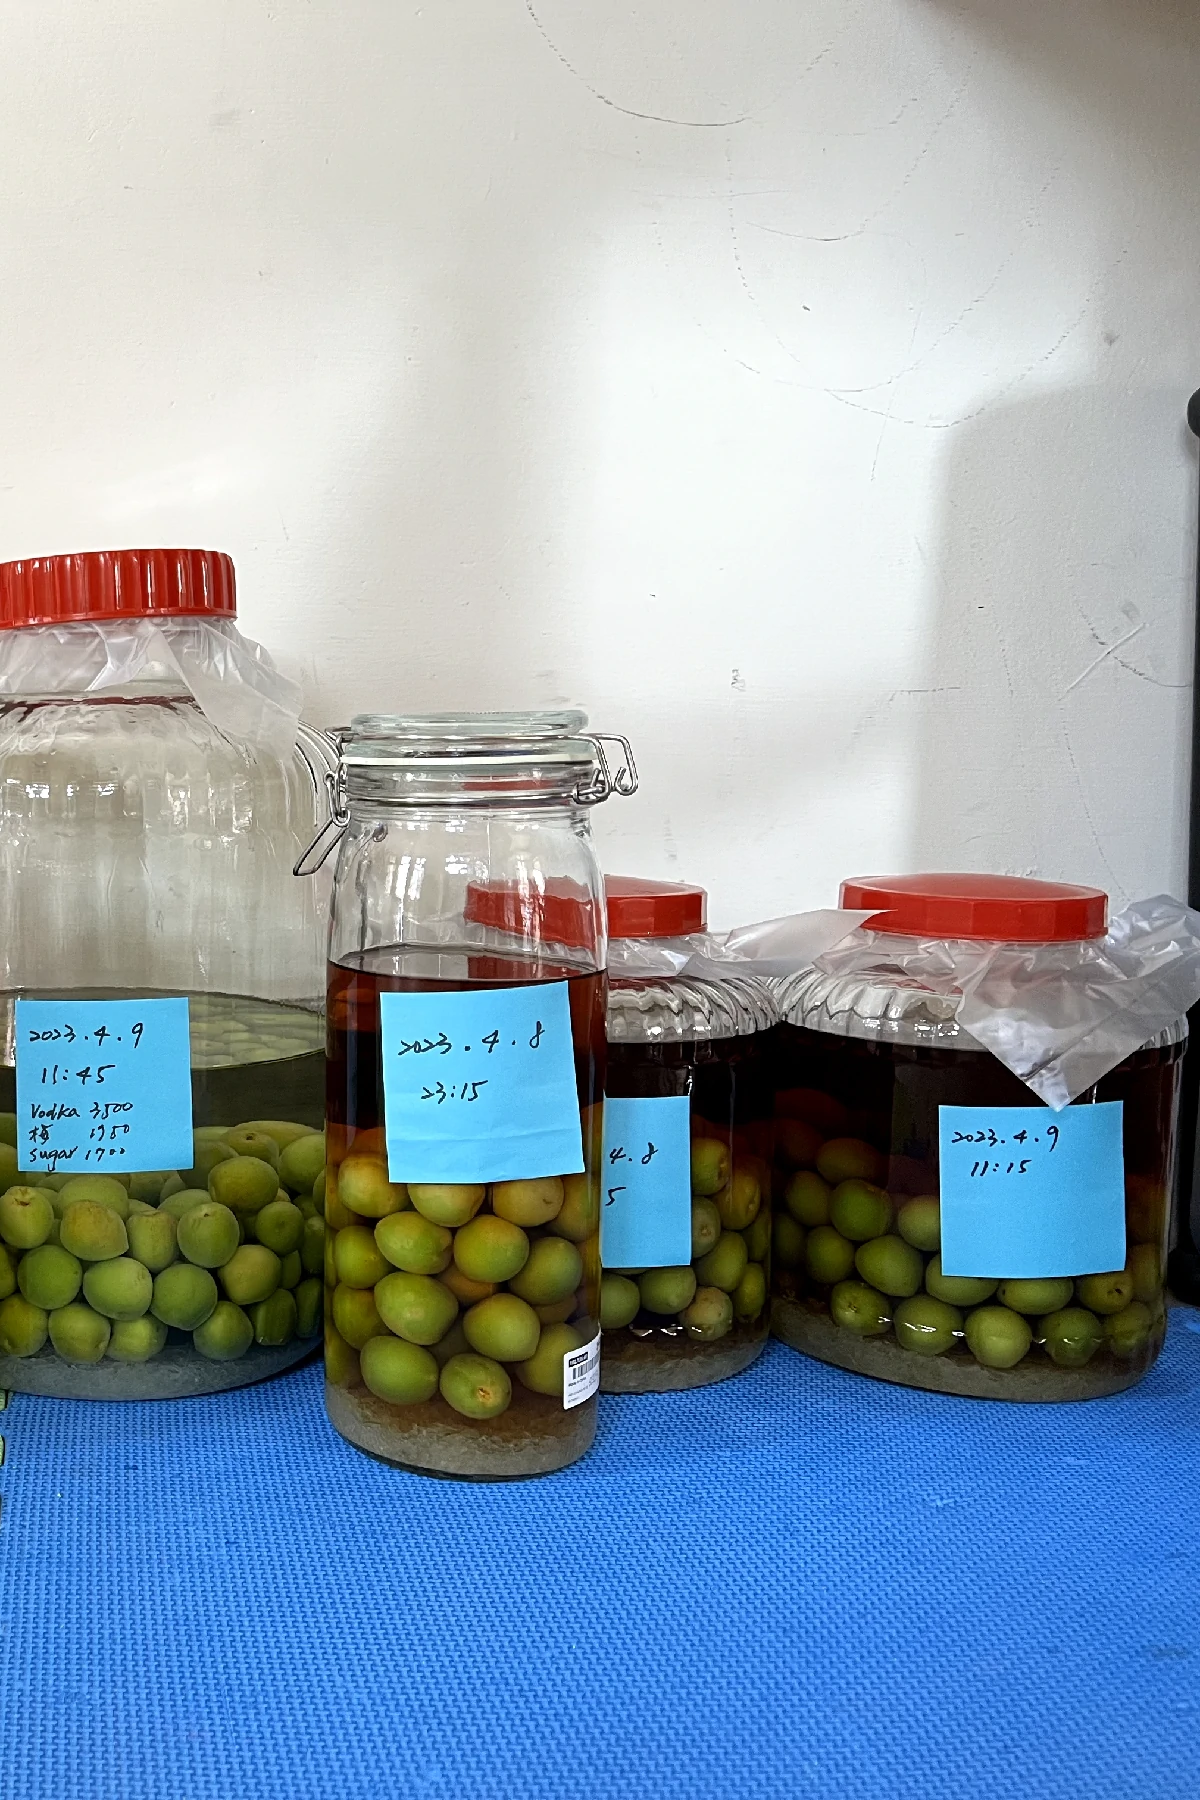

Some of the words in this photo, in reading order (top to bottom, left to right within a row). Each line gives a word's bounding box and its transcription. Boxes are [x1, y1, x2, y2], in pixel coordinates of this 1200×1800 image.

[29, 1022, 144, 1049] 2023.4.9
[41, 1064, 116, 1086] 11:45
[420, 1079, 489, 1105] 23:15
[89, 1101, 134, 1120] 3500
[951, 1125, 1060, 1153] 2023.4.9
[84, 1148, 126, 1162] 1700
[970, 1159, 1033, 1178] 11:15
